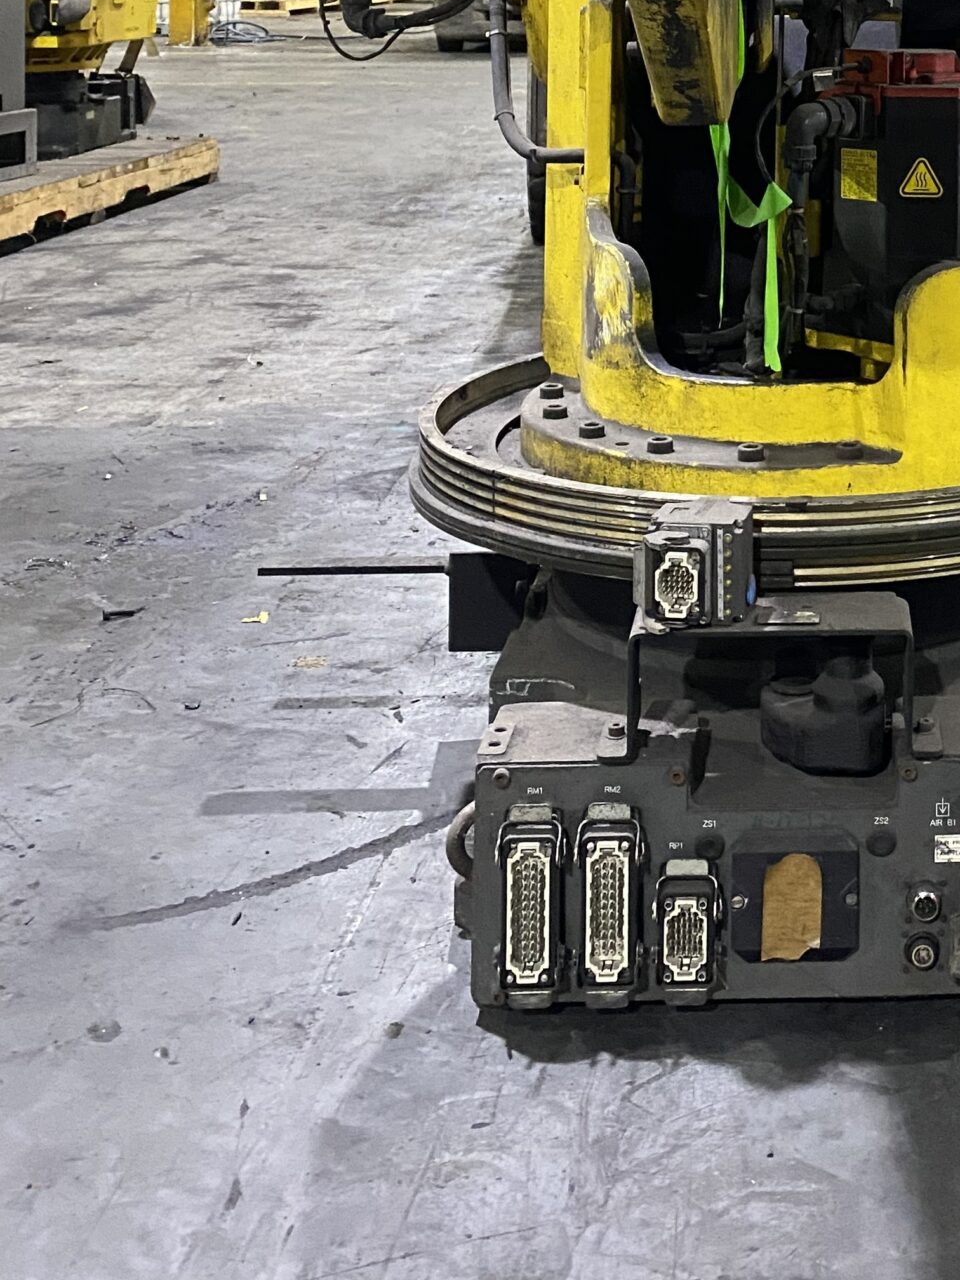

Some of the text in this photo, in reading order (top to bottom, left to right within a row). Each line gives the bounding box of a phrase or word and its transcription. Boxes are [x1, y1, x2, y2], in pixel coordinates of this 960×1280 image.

[527, 787, 543, 795] RM1
[604, 785, 621, 794] RM2
[702, 819, 717, 828] ZS1
[874, 816, 889, 825] ZS2
[930, 819, 943, 827] AIR
[669, 841, 683, 850] RP1
